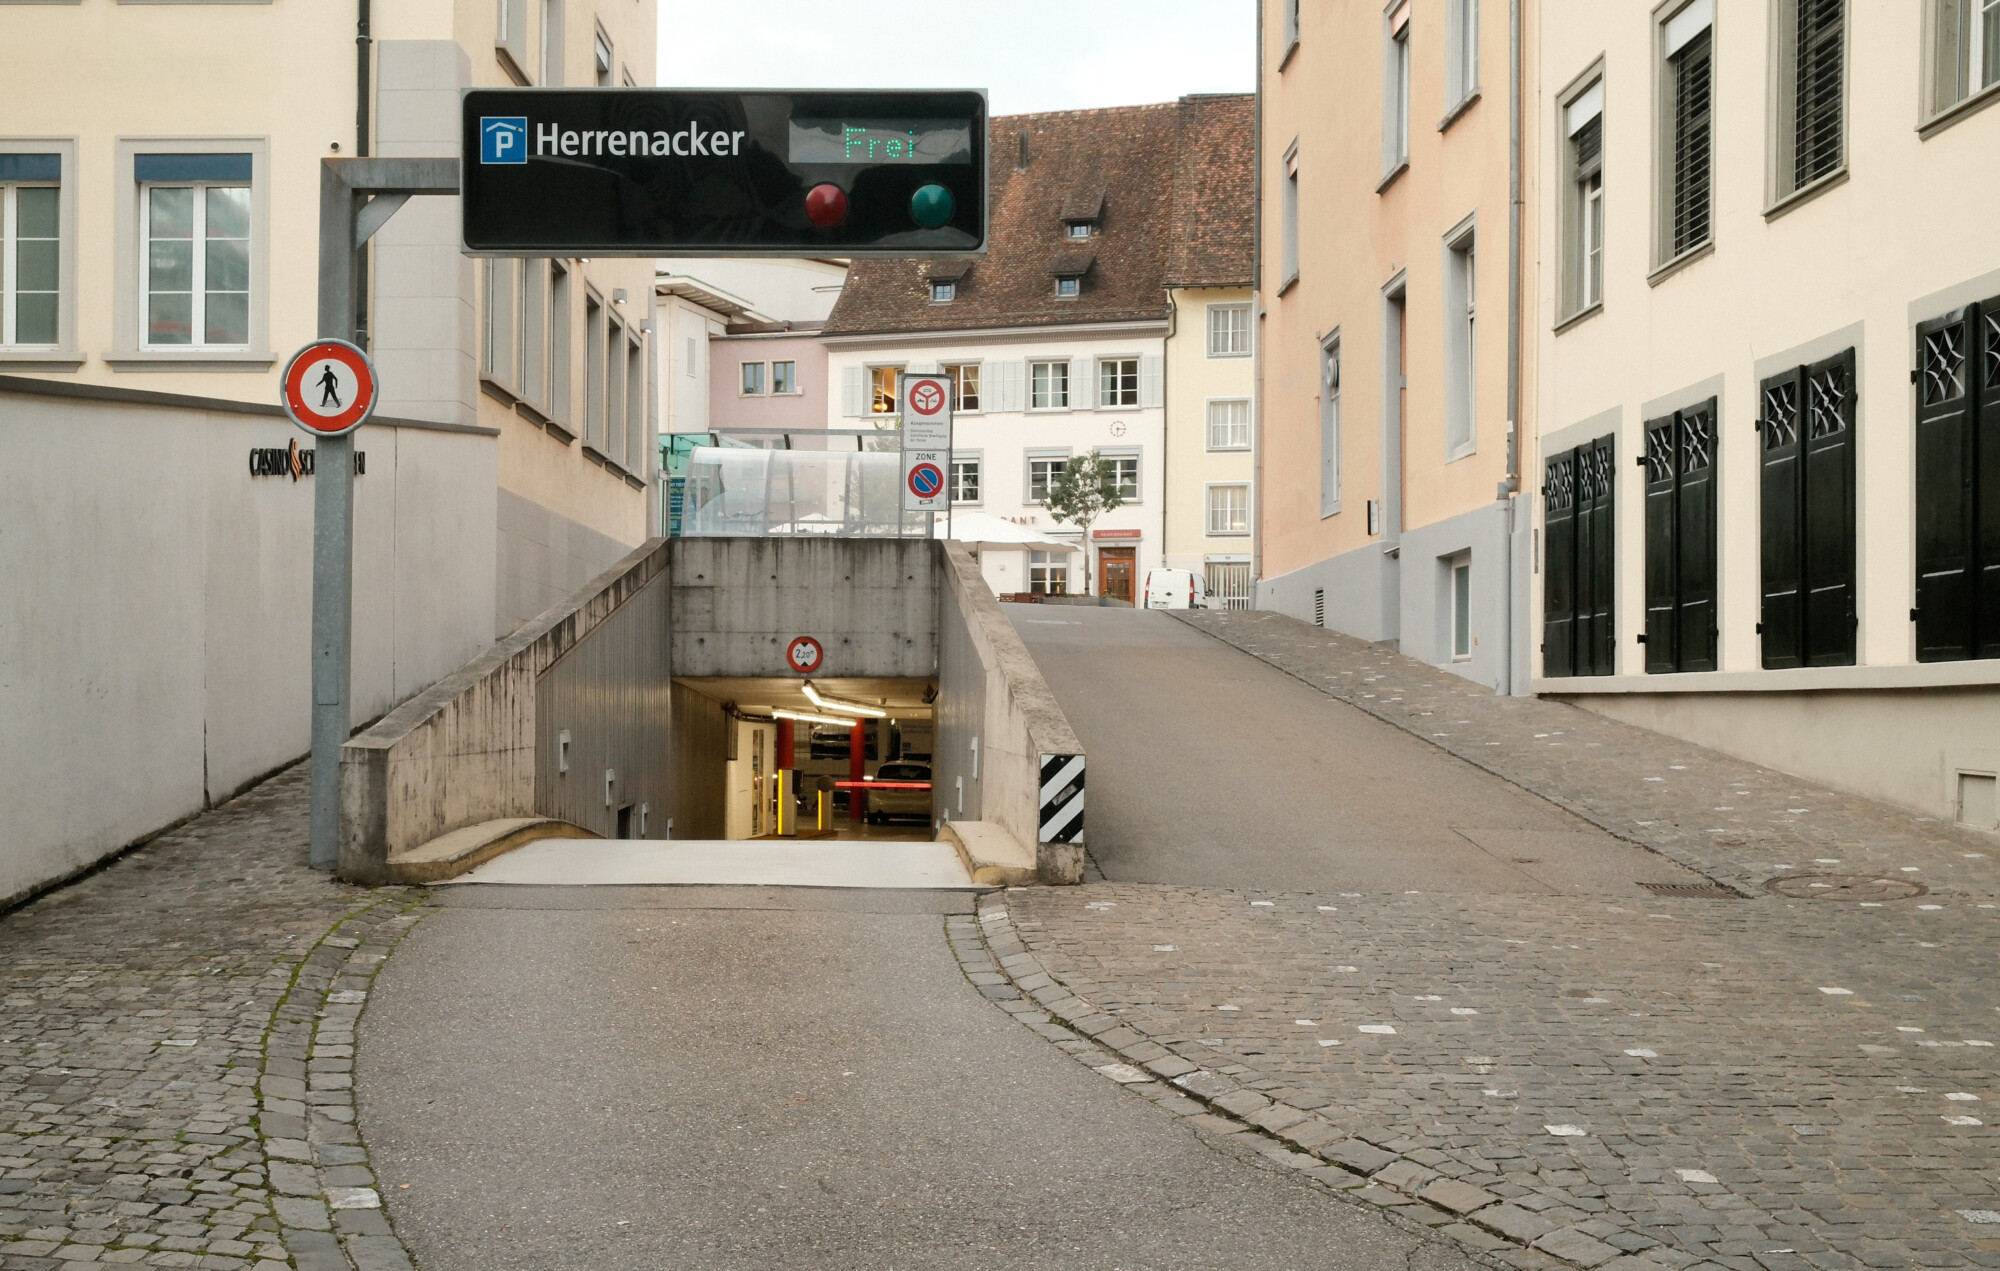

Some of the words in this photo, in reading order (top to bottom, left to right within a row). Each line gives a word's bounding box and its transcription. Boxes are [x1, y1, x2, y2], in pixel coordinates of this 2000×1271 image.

[537, 121, 745, 156] Herrenacker
[846, 127, 914, 157] Frei
[249, 448, 290, 475] CASINO
